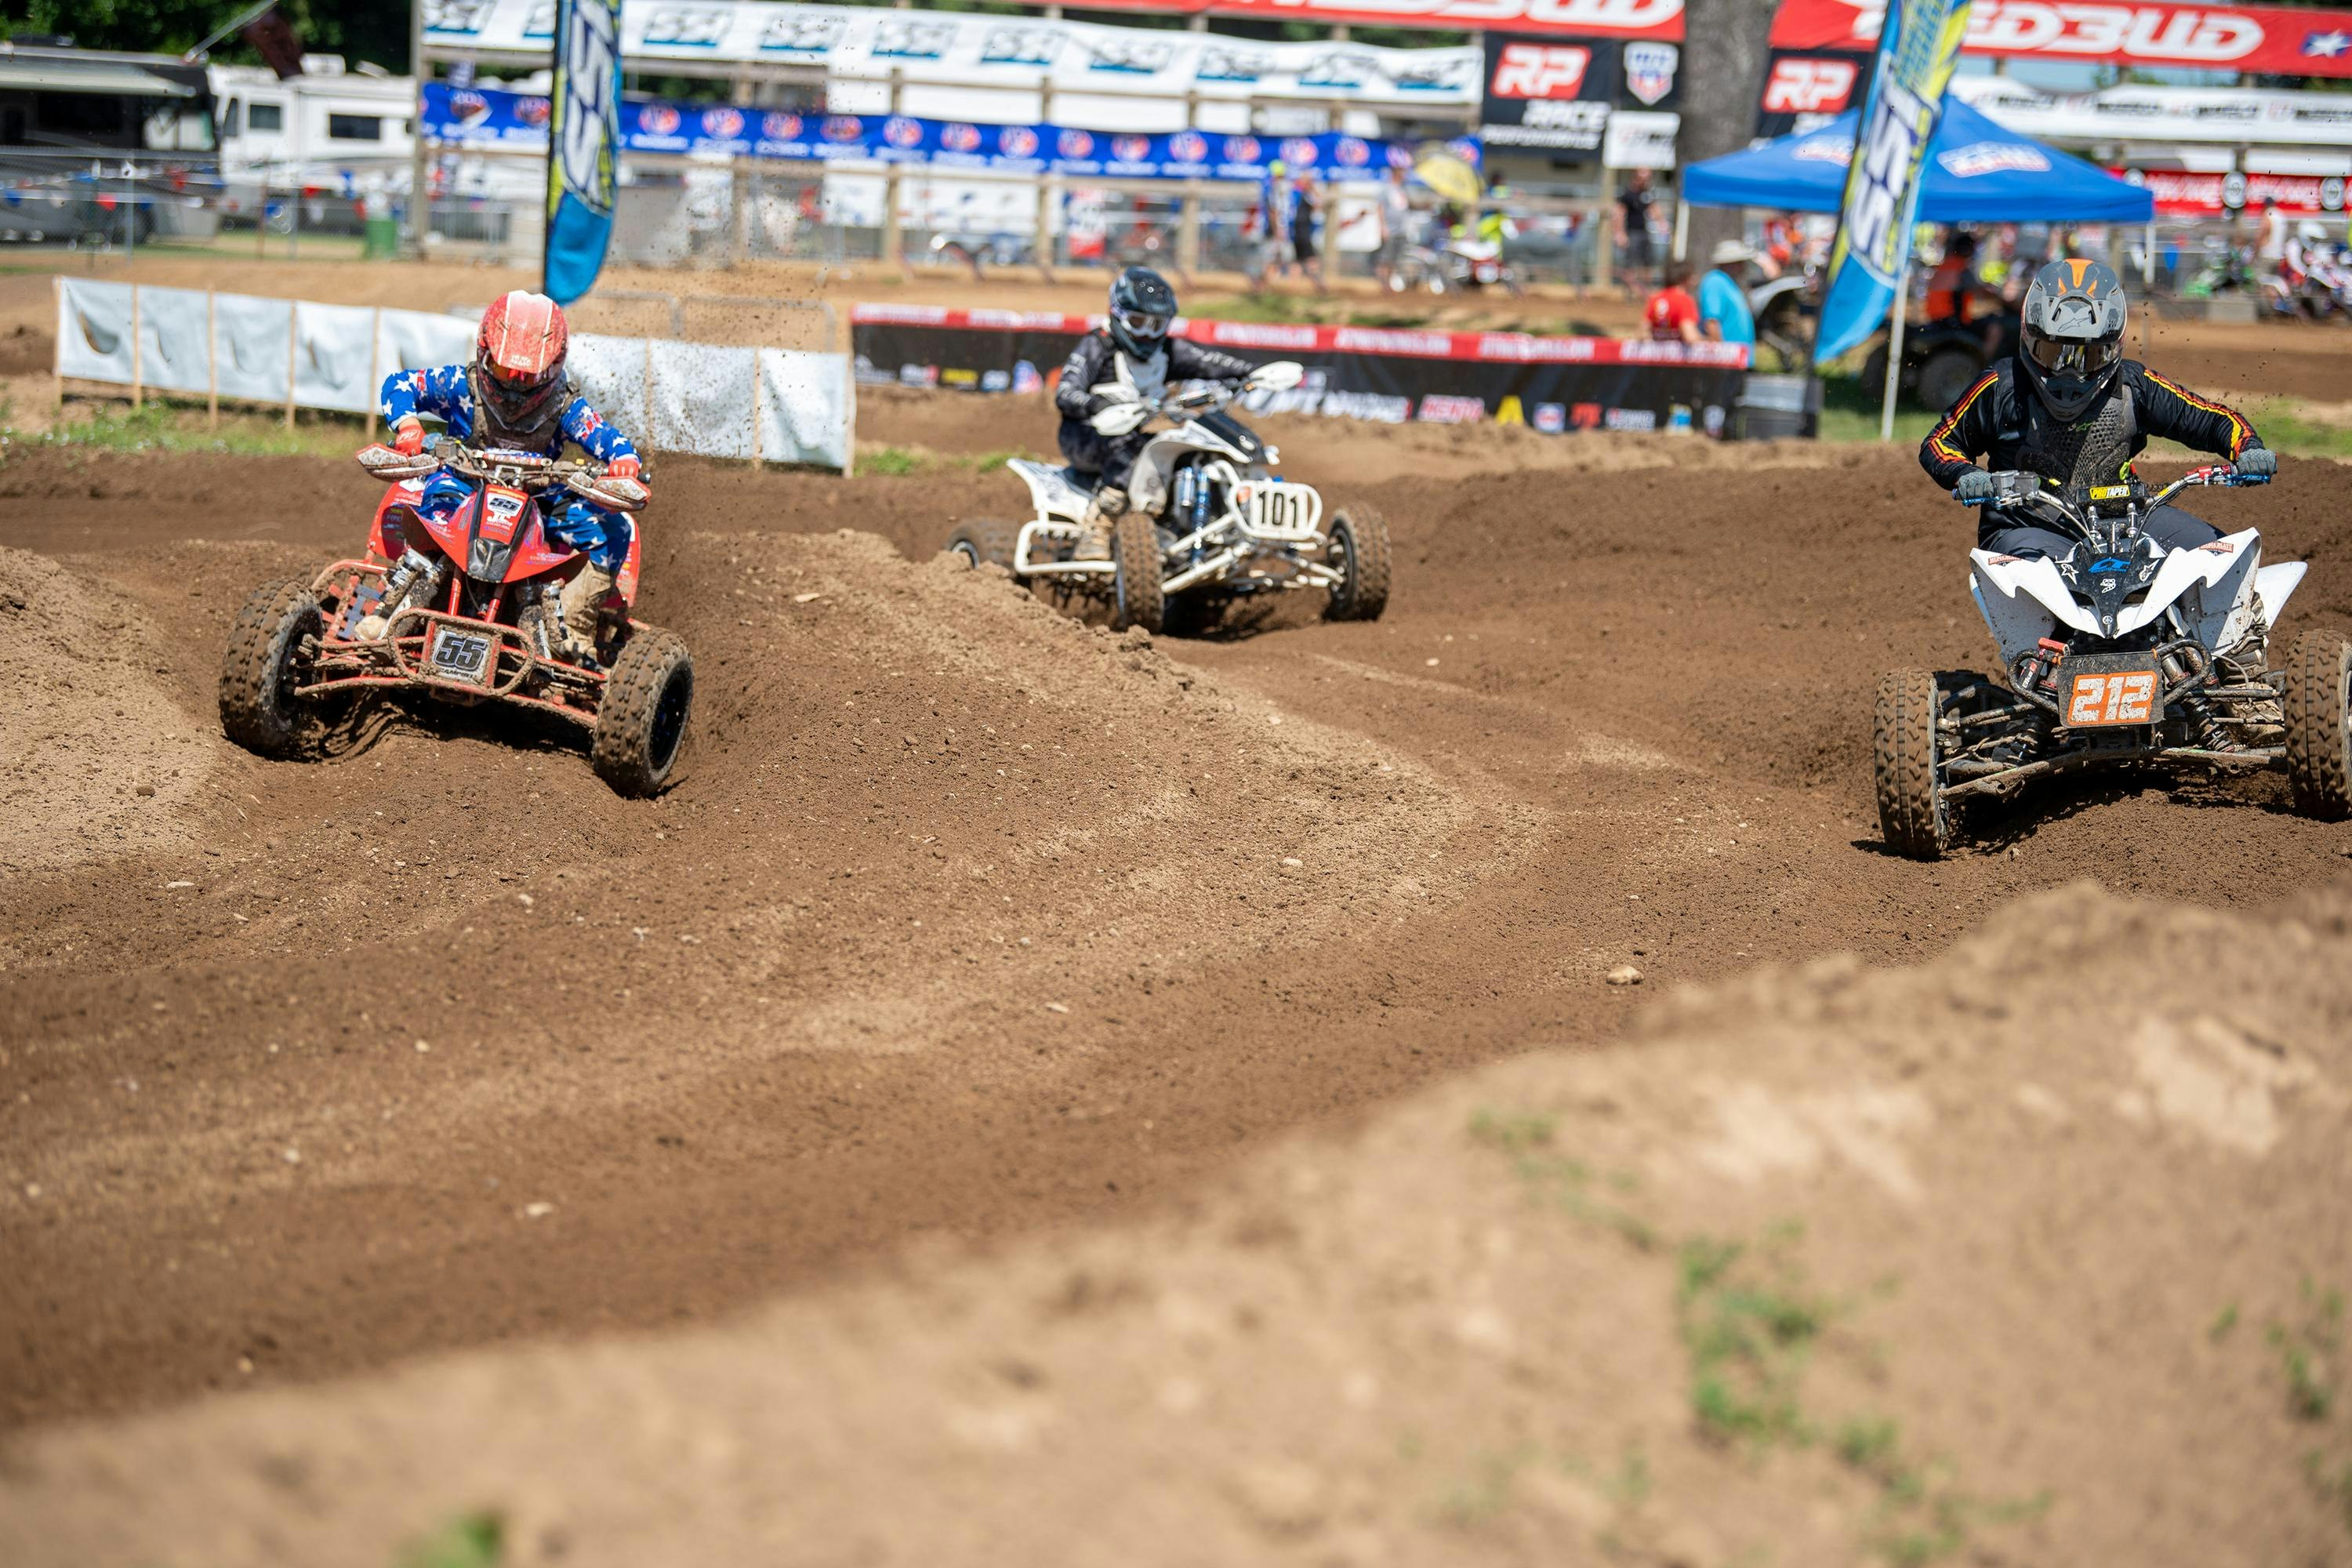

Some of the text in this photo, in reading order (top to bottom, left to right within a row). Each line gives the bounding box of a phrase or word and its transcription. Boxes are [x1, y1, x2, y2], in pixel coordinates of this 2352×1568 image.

[1493, 46, 1588, 96] RP
[1765, 60, 1855, 111] RP
[488, 497, 521, 511] 55
[1258, 491, 1298, 528] 101
[2091, 486, 2129, 499] PROTAPER
[434, 634, 488, 671] 55
[2071, 675, 2154, 723] 212
